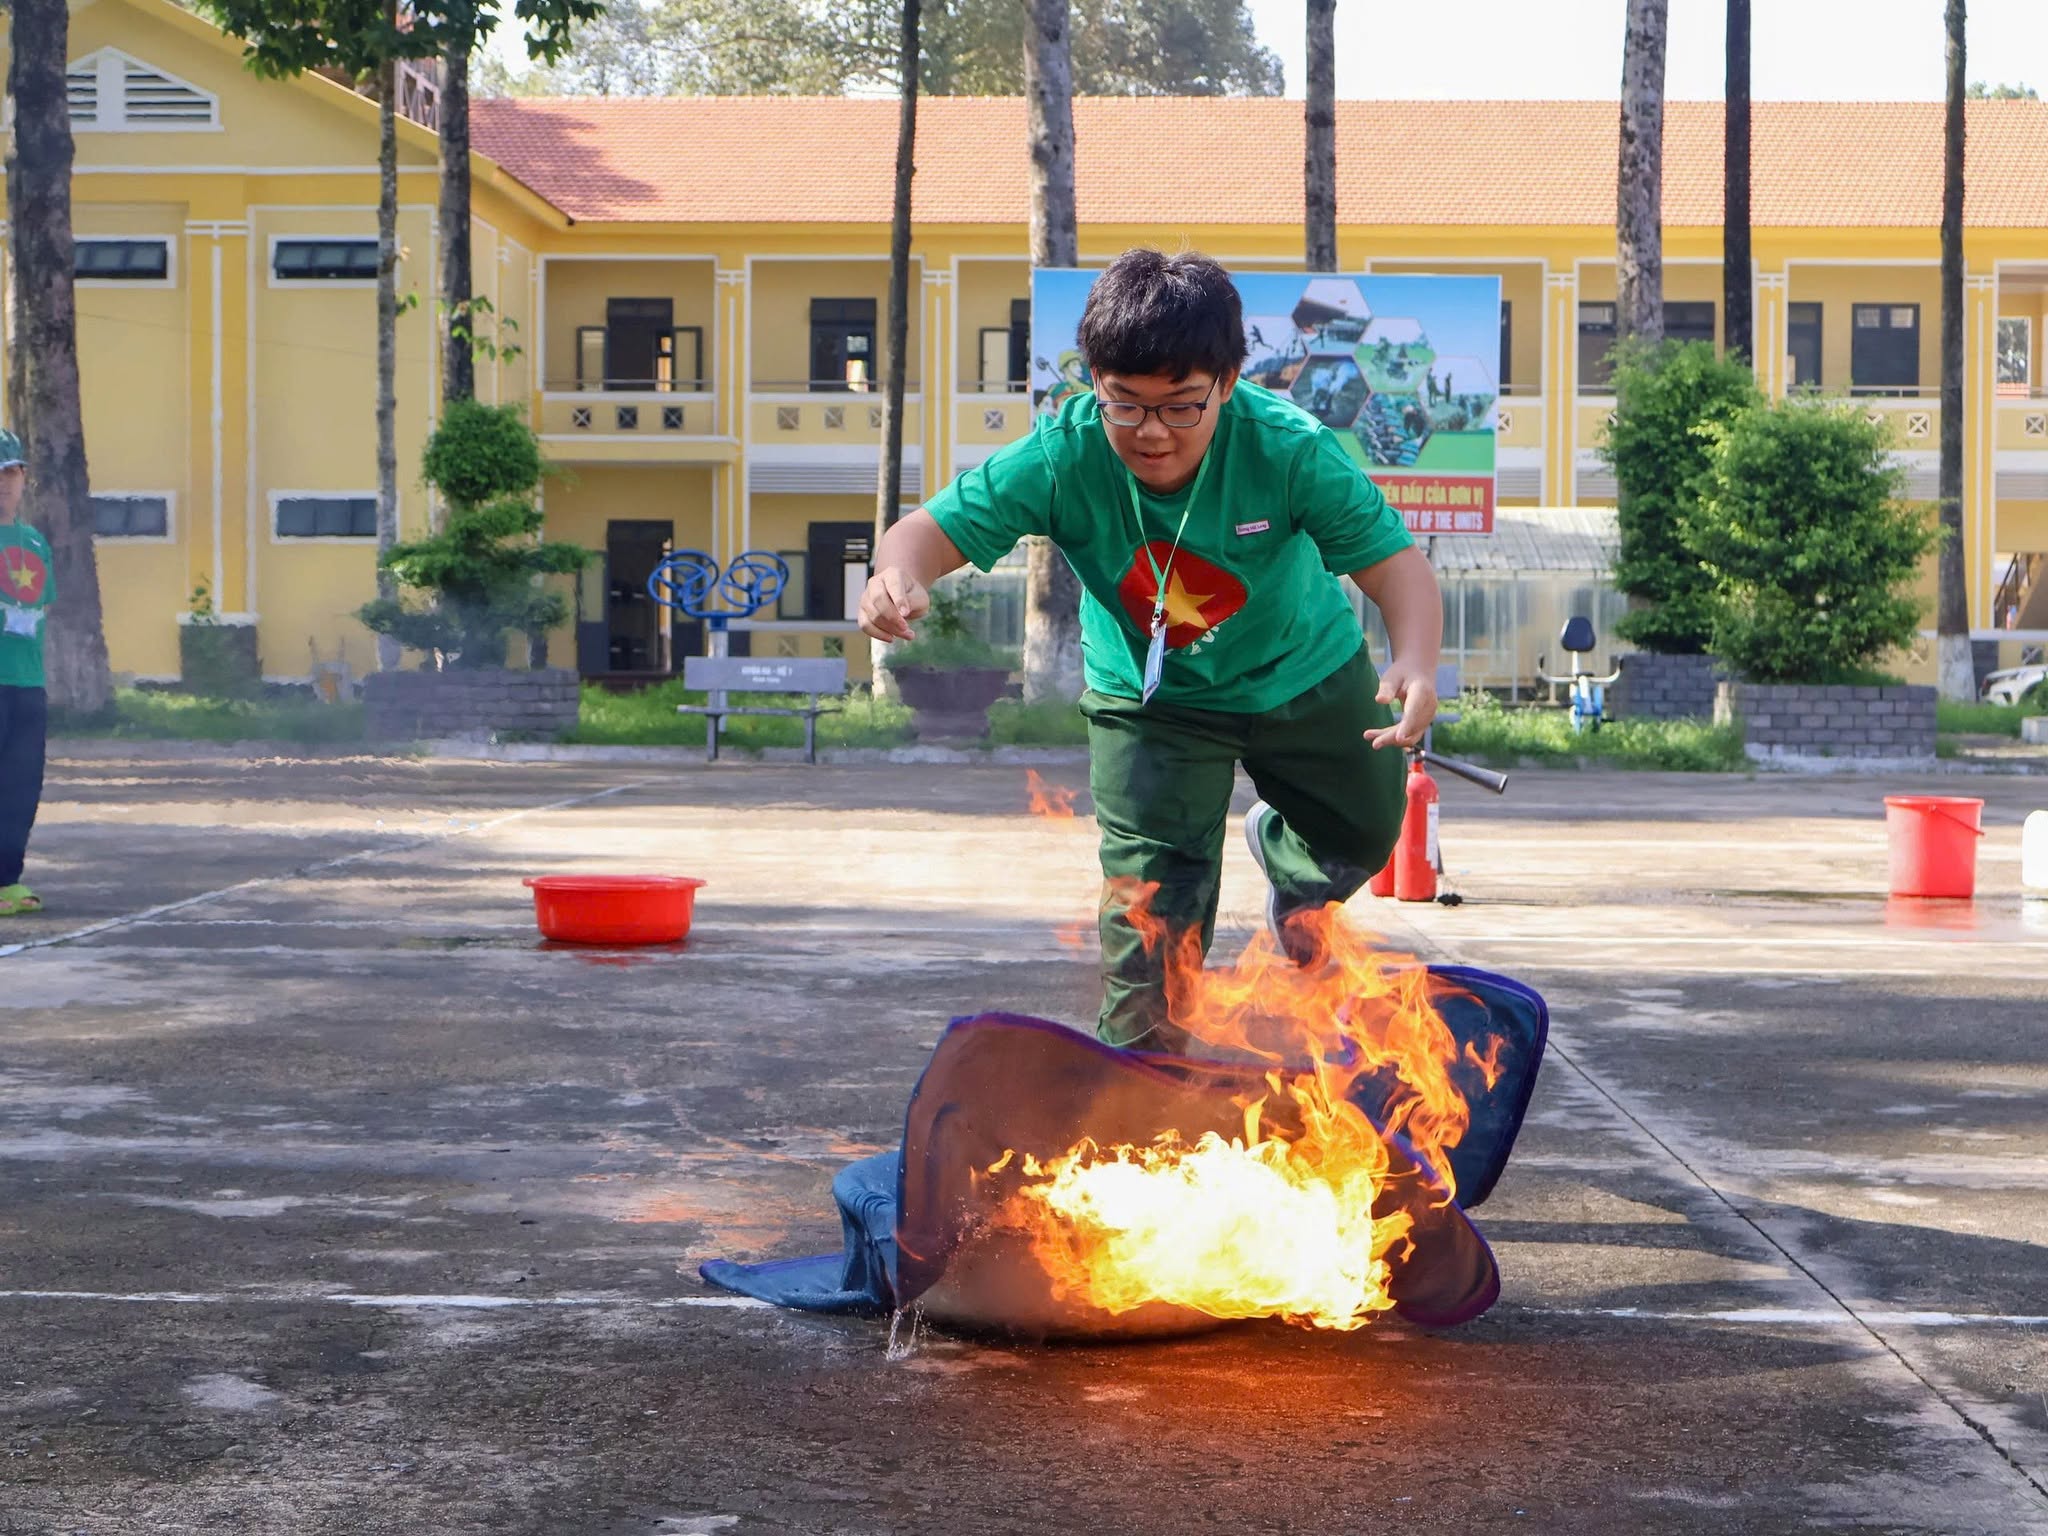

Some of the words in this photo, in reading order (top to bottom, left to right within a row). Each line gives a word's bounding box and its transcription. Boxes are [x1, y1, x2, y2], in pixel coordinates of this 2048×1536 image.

[1425, 480, 1447, 505] CỦA
[1473, 486, 1484, 509] VỊ
[1420, 510, 1433, 530] OF
[1434, 511, 1453, 530] THE
[1454, 511, 1484, 531] UNITS
